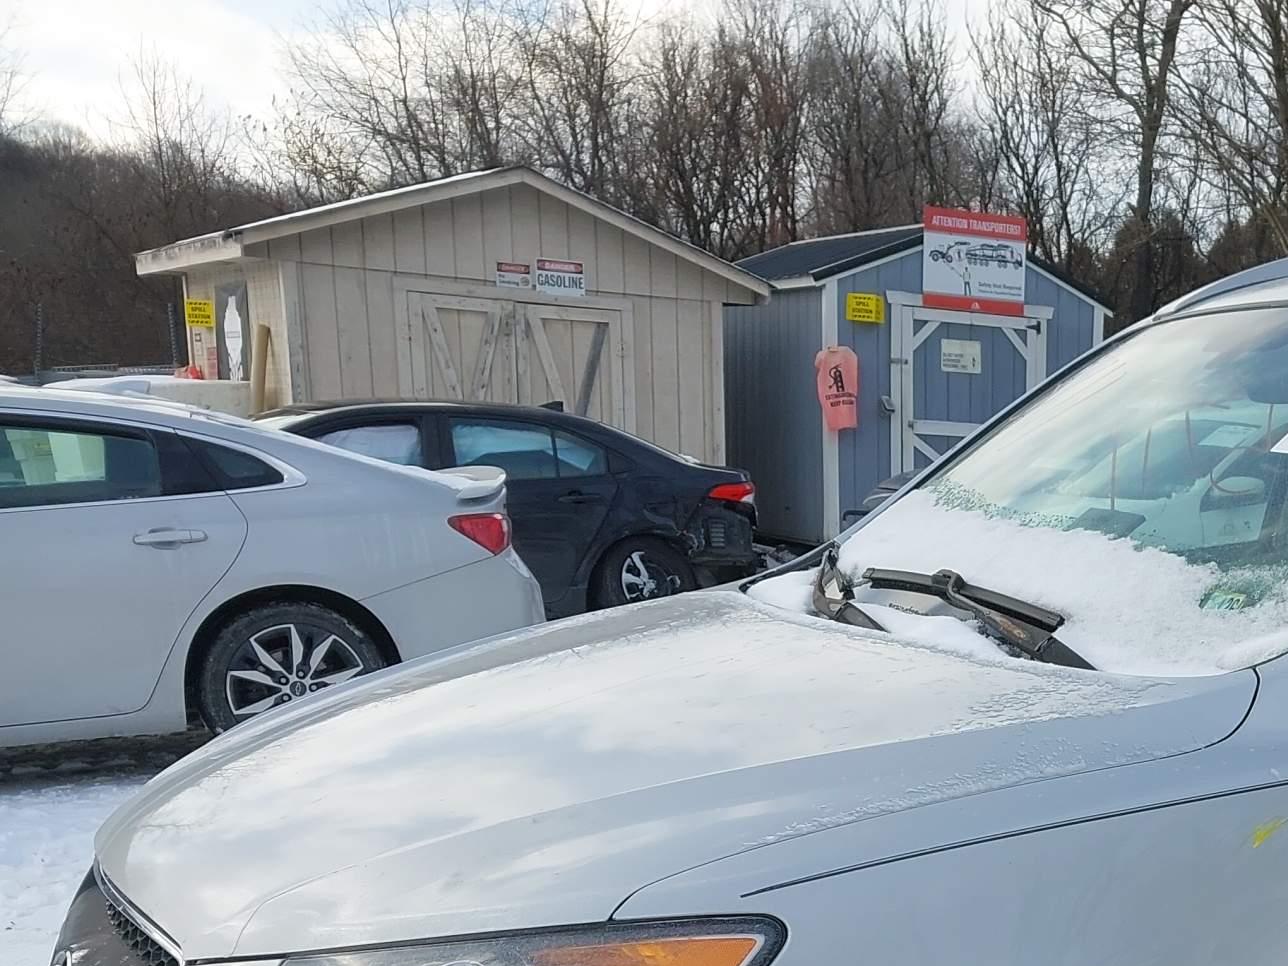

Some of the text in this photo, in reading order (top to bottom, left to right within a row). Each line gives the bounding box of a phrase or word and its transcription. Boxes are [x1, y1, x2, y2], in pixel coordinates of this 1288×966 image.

[931, 215, 1021, 235] ATTENTION TRANSPORTERS!
[537, 273, 584, 290] GASOLINE
